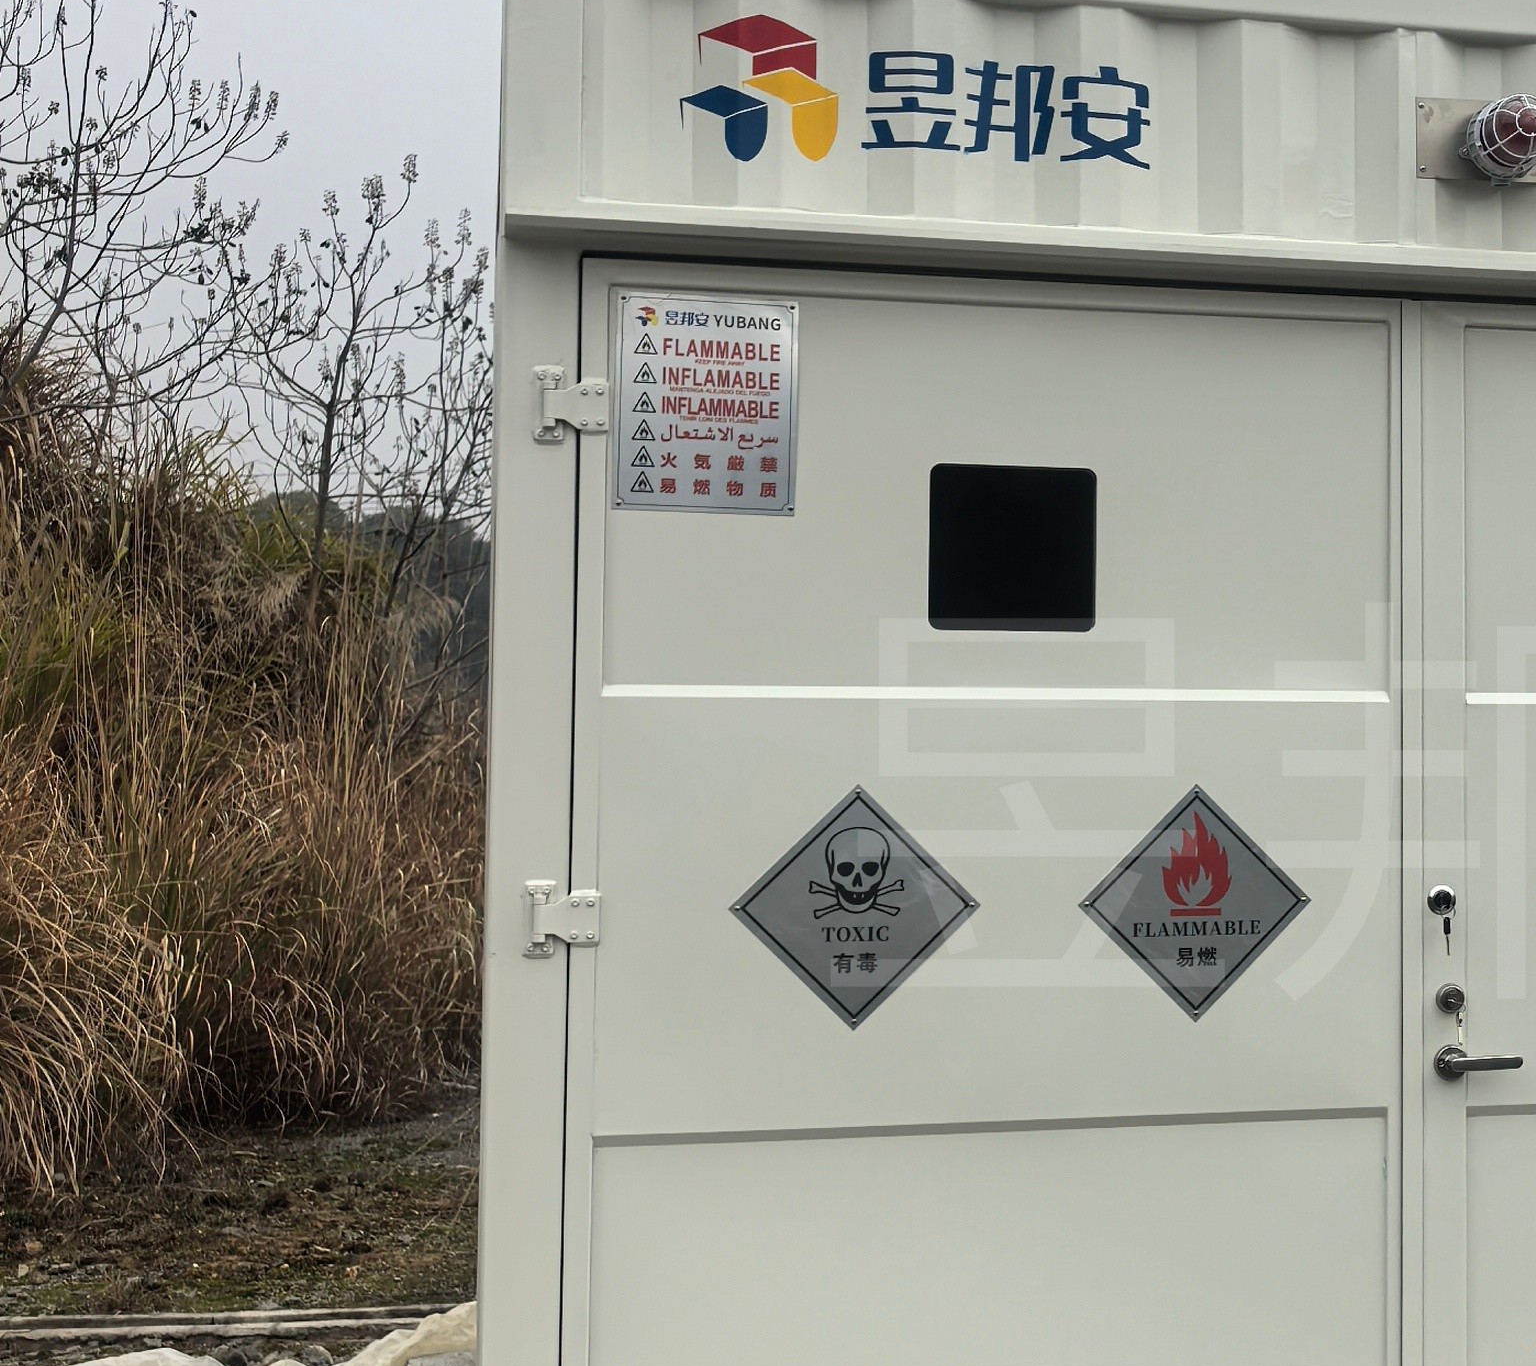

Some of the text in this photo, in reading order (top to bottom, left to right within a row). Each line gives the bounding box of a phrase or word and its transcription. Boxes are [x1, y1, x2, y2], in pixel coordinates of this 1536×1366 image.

[862, 51, 1150, 170] 昱邦安
[664, 310, 781, 332] 昱邦安 YUBANG
[662, 337, 781, 362] FLAMMABLE
[662, 366, 780, 391] INFLAMABLE
[669, 385, 704, 394] MANTENGA
[661, 396, 779, 419] INFLAMMABLE
[660, 423, 779, 450] سريع الاشتعال
[659, 478, 777, 498] 易燃物质
[821, 925, 890, 942] TOXIC
[1132, 919, 1262, 938] FLAMMABLE
[833, 952, 878, 974] 有毒
[1176, 946, 1218, 968] 易燃
